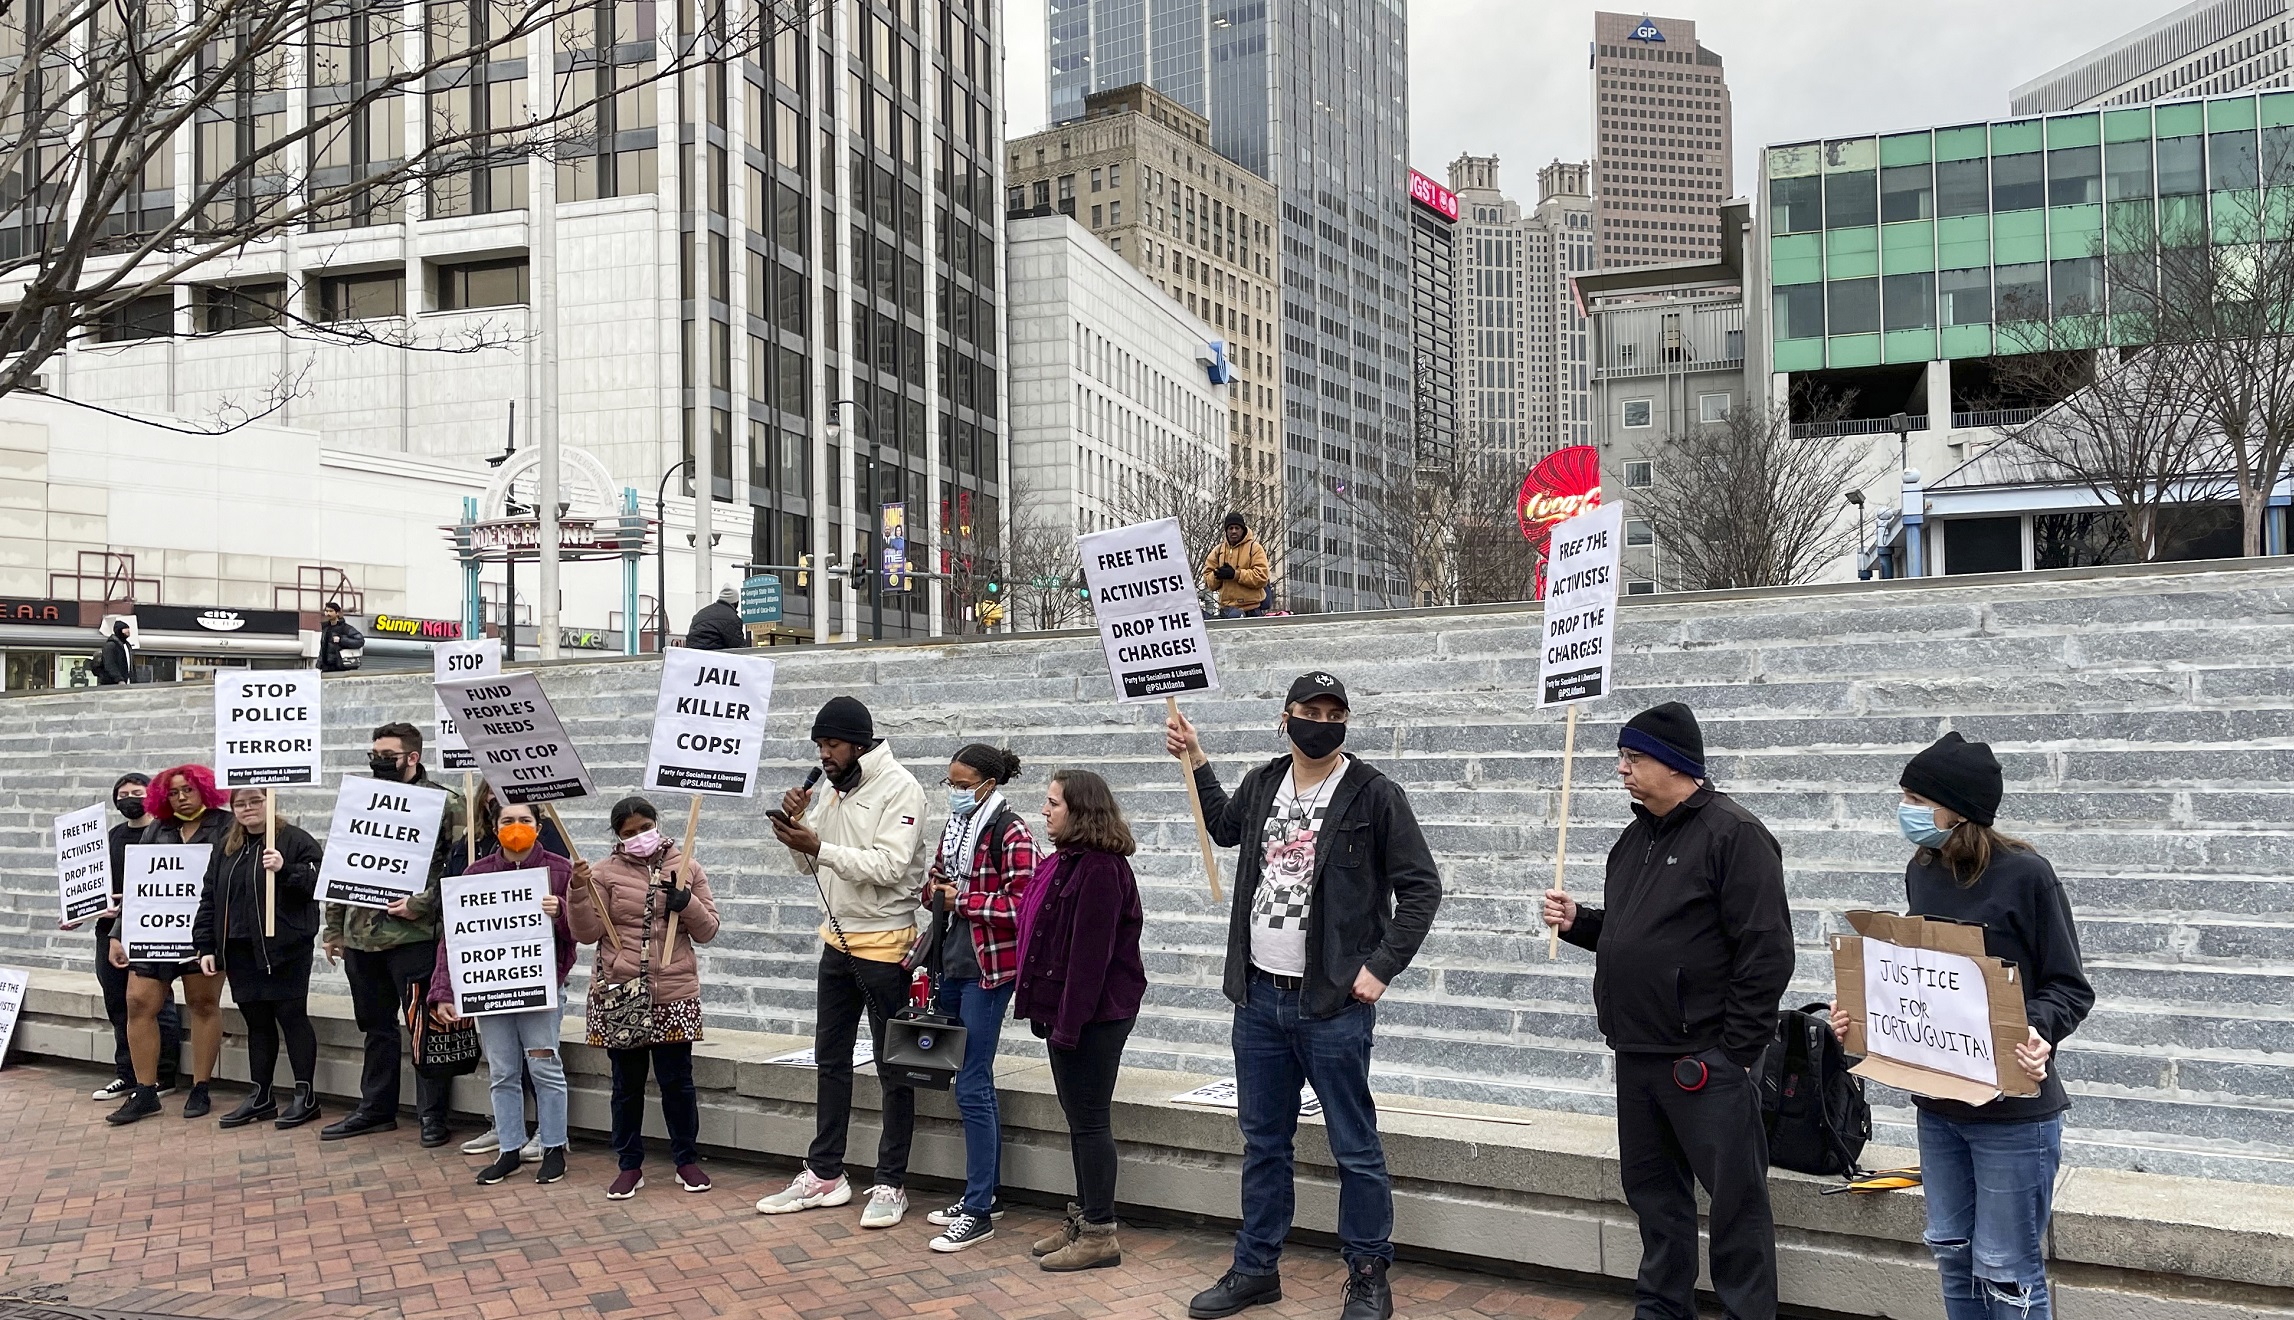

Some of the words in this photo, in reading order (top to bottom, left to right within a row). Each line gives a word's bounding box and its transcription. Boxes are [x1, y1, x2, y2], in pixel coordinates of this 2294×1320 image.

[1637, 26, 1657, 38] GP
[1559, 537, 1584, 561] FREE
[1586, 530, 1608, 552] THE
[1097, 549, 1134, 571] FREE
[1135, 543, 1169, 564] THE
[1100, 574, 1185, 604] ACTIVISTS!
[1552, 565, 1610, 597] ACTIVISTS!
[746, 588, 758, 597] Georgia
[746, 597, 767, 606] Underground
[204, 610, 239, 620] city
[760, 606, 777, 614] Coca-Cola
[376, 615, 420, 636] Sunny
[422, 620, 463, 638] NAILS
[1111, 618, 1154, 639] DROP
[1158, 612, 1192, 632] THE
[1550, 614, 1580, 638] DROP
[1582, 608, 1605, 630] THE
[559, 627, 609, 648] ricket
[1118, 637, 1197, 663] CHARGES!
[1548, 637, 1602, 665] CHARGES!
[448, 653, 483, 671] STOP
[694, 666, 740, 687] JAIL
[1138, 675, 1146, 683] for
[1146, 672, 1171, 681] Socialism
[1175, 668, 1203, 677] Liberation
[1546, 680, 1554, 689] Party
[1560, 676, 1577, 686] Socialism
[1581, 672, 1601, 682] Liberation
[242, 684, 297, 698] STOP
[465, 685, 512, 701] FUND
[1145, 680, 1185, 694] @PSLAtlanta
[1558, 686, 1586, 700] @PSLAtlanta
[232, 706, 307, 722] POLICE
[462, 700, 535, 720] PEOPLE'S
[676, 696, 750, 721] KILLER
[482, 719, 535, 736] NEEDS
[226, 738, 312, 754] TERROR!
[676, 733, 741, 755] COPS!
[486, 748, 522, 764] NOT
[525, 743, 558, 759] COP
[250, 776, 290, 785] @PSLAtlanta
[512, 765, 555, 781] CITY!
[660, 768, 675, 776] Party
[685, 771, 712, 779] Socialism
[717, 774, 744, 782] Liberation
[505, 788, 519, 796] Party
[526, 785, 549, 793] Socialism
[554, 781, 580, 790] Liberation
[680, 778, 722, 789] @PSLAtlanta
[366, 793, 411, 813] JAIL
[526, 791, 565, 801] @PSLAtlanta
[62, 825, 80, 839] FREE
[82, 820, 98, 834] THE
[349, 818, 420, 843] KILLER
[61, 839, 104, 860] ACTIVISTS!
[65, 866, 86, 882] DROP
[89, 861, 104, 874] THE
[148, 857, 185, 874] JAIL
[347, 852, 409, 874] COPS!
[66, 877, 104, 897] CHARGES!
[137, 883, 196, 897] KILLER
[330, 882, 344, 890] Party
[354, 886, 379, 895] Socialism
[348, 892, 389, 904] @PSLAtlanta
[460, 892, 497, 908] FREE
[501, 888, 533, 903] THE
[140, 914, 191, 928] COPS!
[454, 913, 542, 935] ACTIVISTS!
[147, 950, 180, 958] @PSLAtlanta
[461, 948, 506, 964] DROP
[511, 944, 542, 959] THE
[463, 964, 543, 984] CHARGES!
[1880, 960, 1960, 990] JUSTICE
[518, 989, 544, 997] Liberation
[484, 999, 525, 1010] @PSLAtlanta
[1899, 997, 1929, 1019] FOR
[1869, 1011, 1990, 1061] TORTUGUITA!
[427, 1048, 478, 1064] BOOKSTORE
